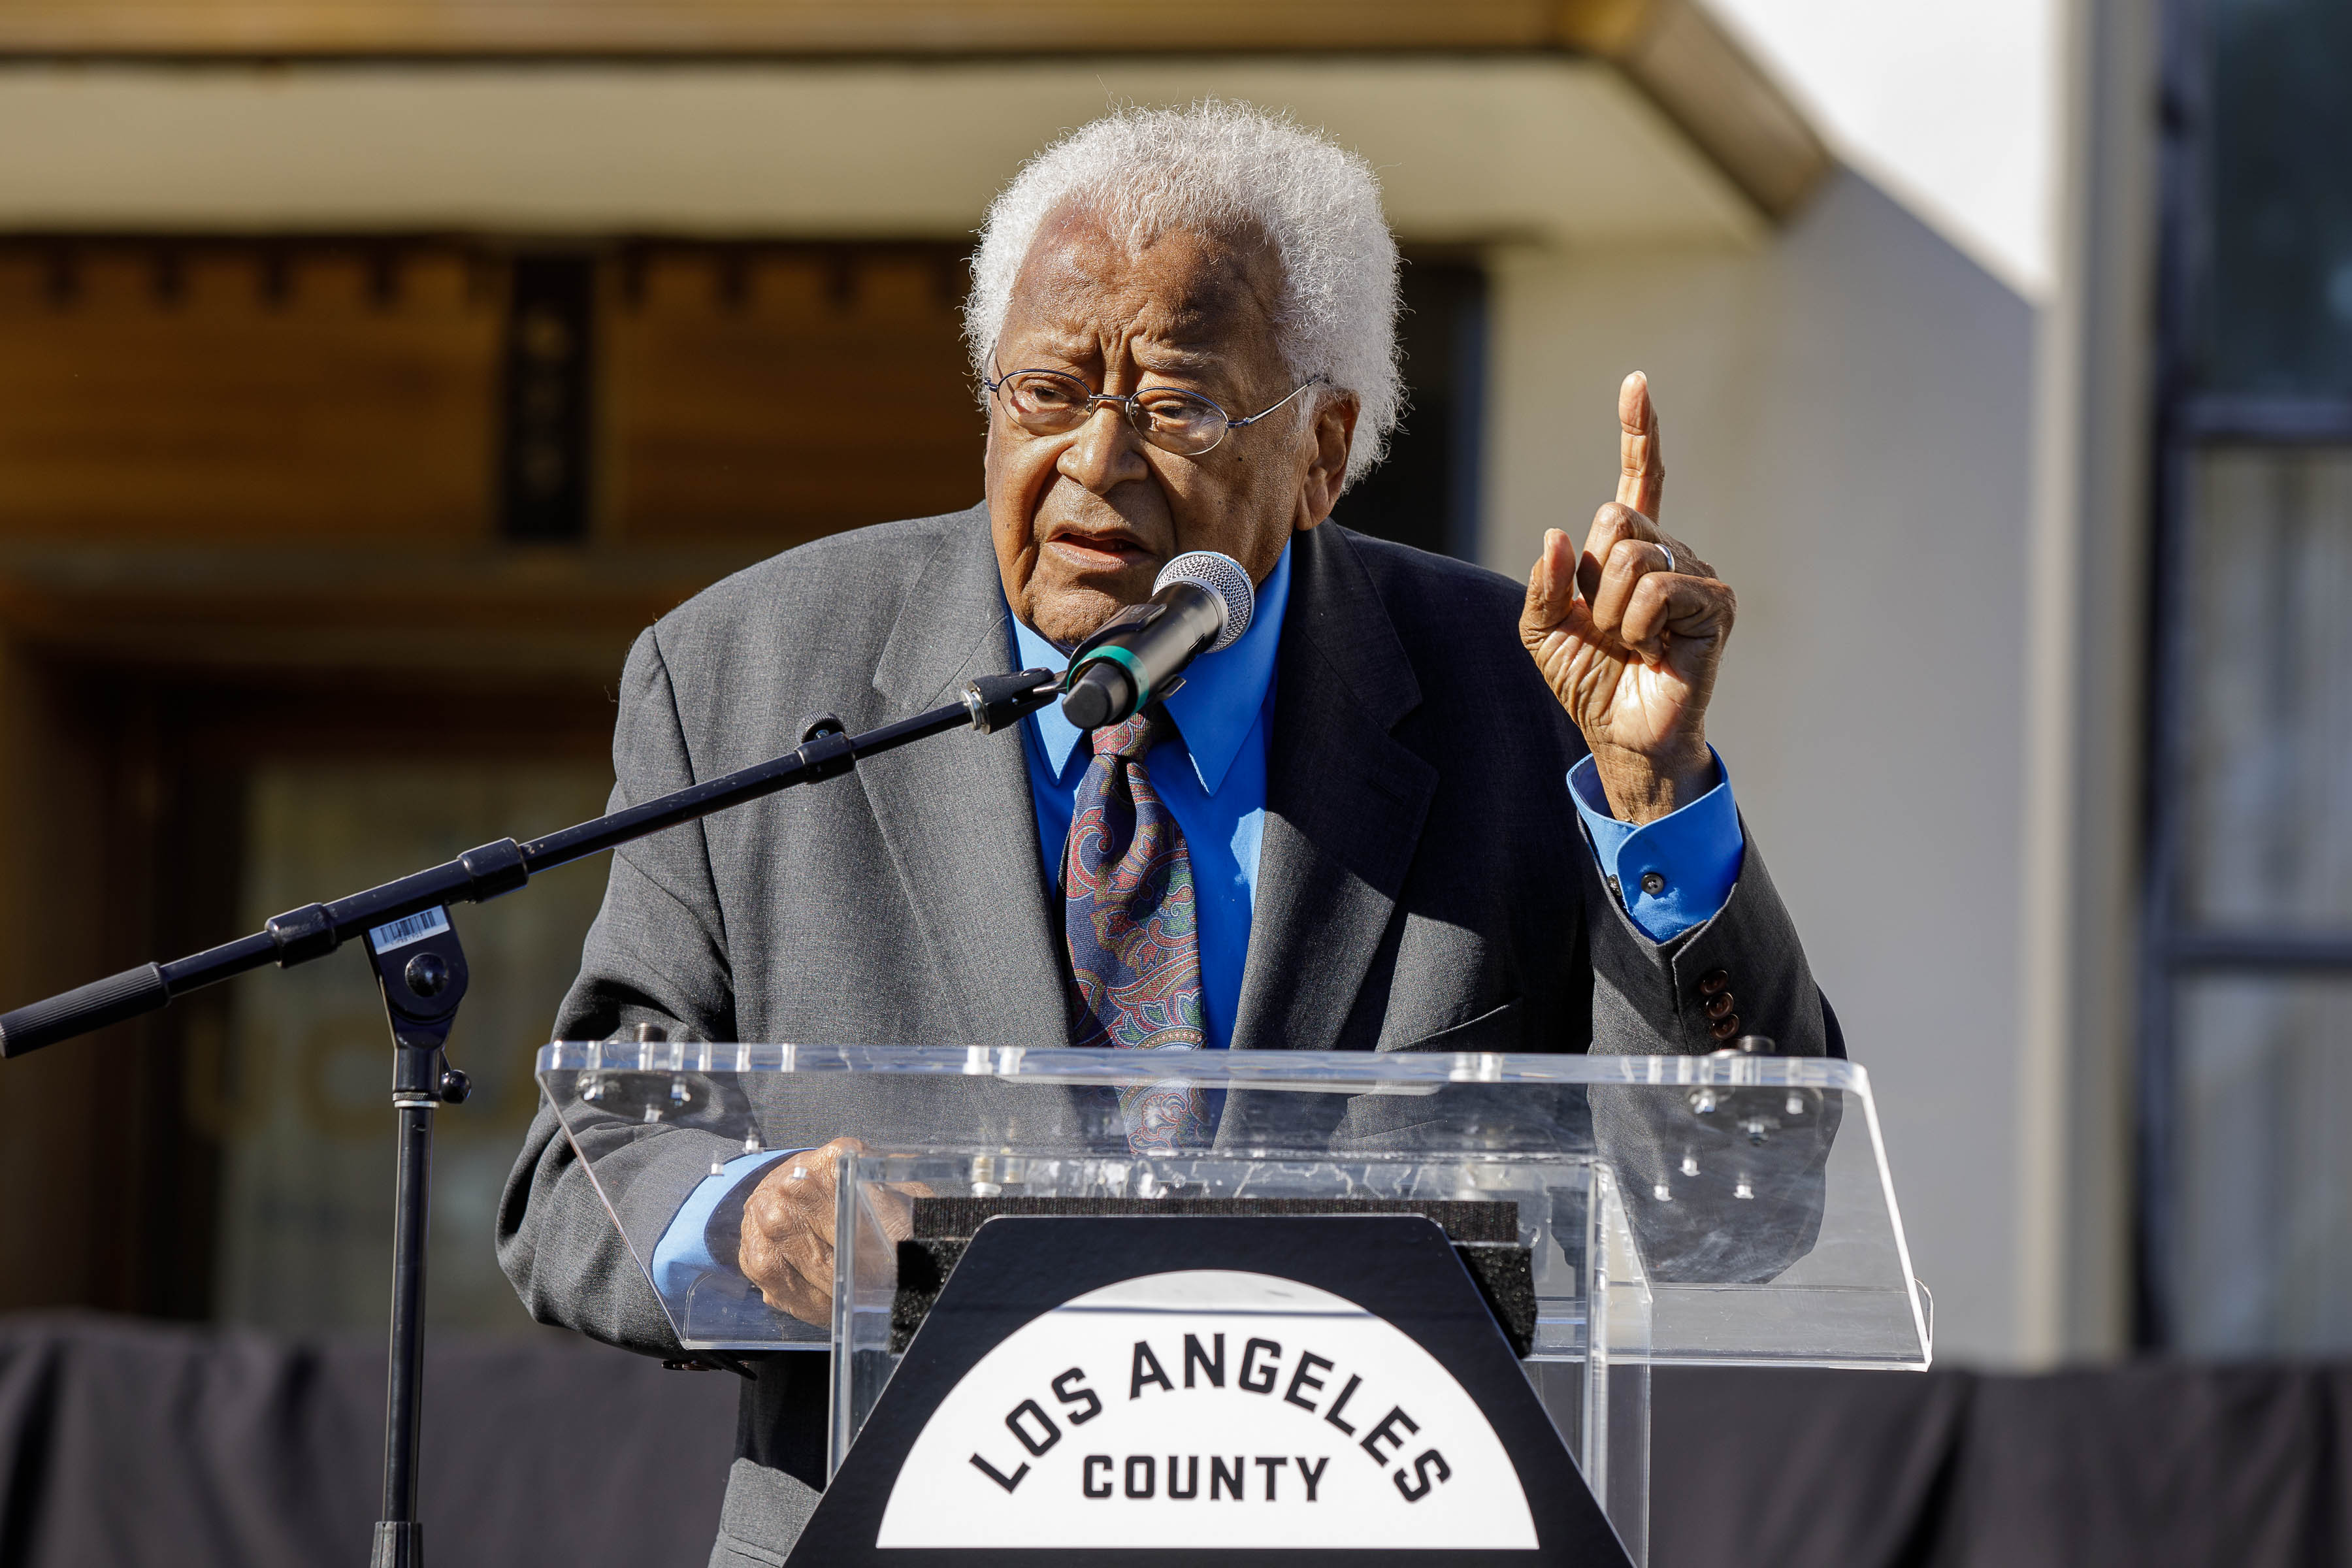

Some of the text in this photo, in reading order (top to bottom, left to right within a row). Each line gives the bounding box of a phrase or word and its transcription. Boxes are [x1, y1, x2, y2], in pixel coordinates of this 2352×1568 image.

[968, 1333, 1451, 1503] LOS ANGELES
[1083, 1454, 1330, 1502] COUNTY
